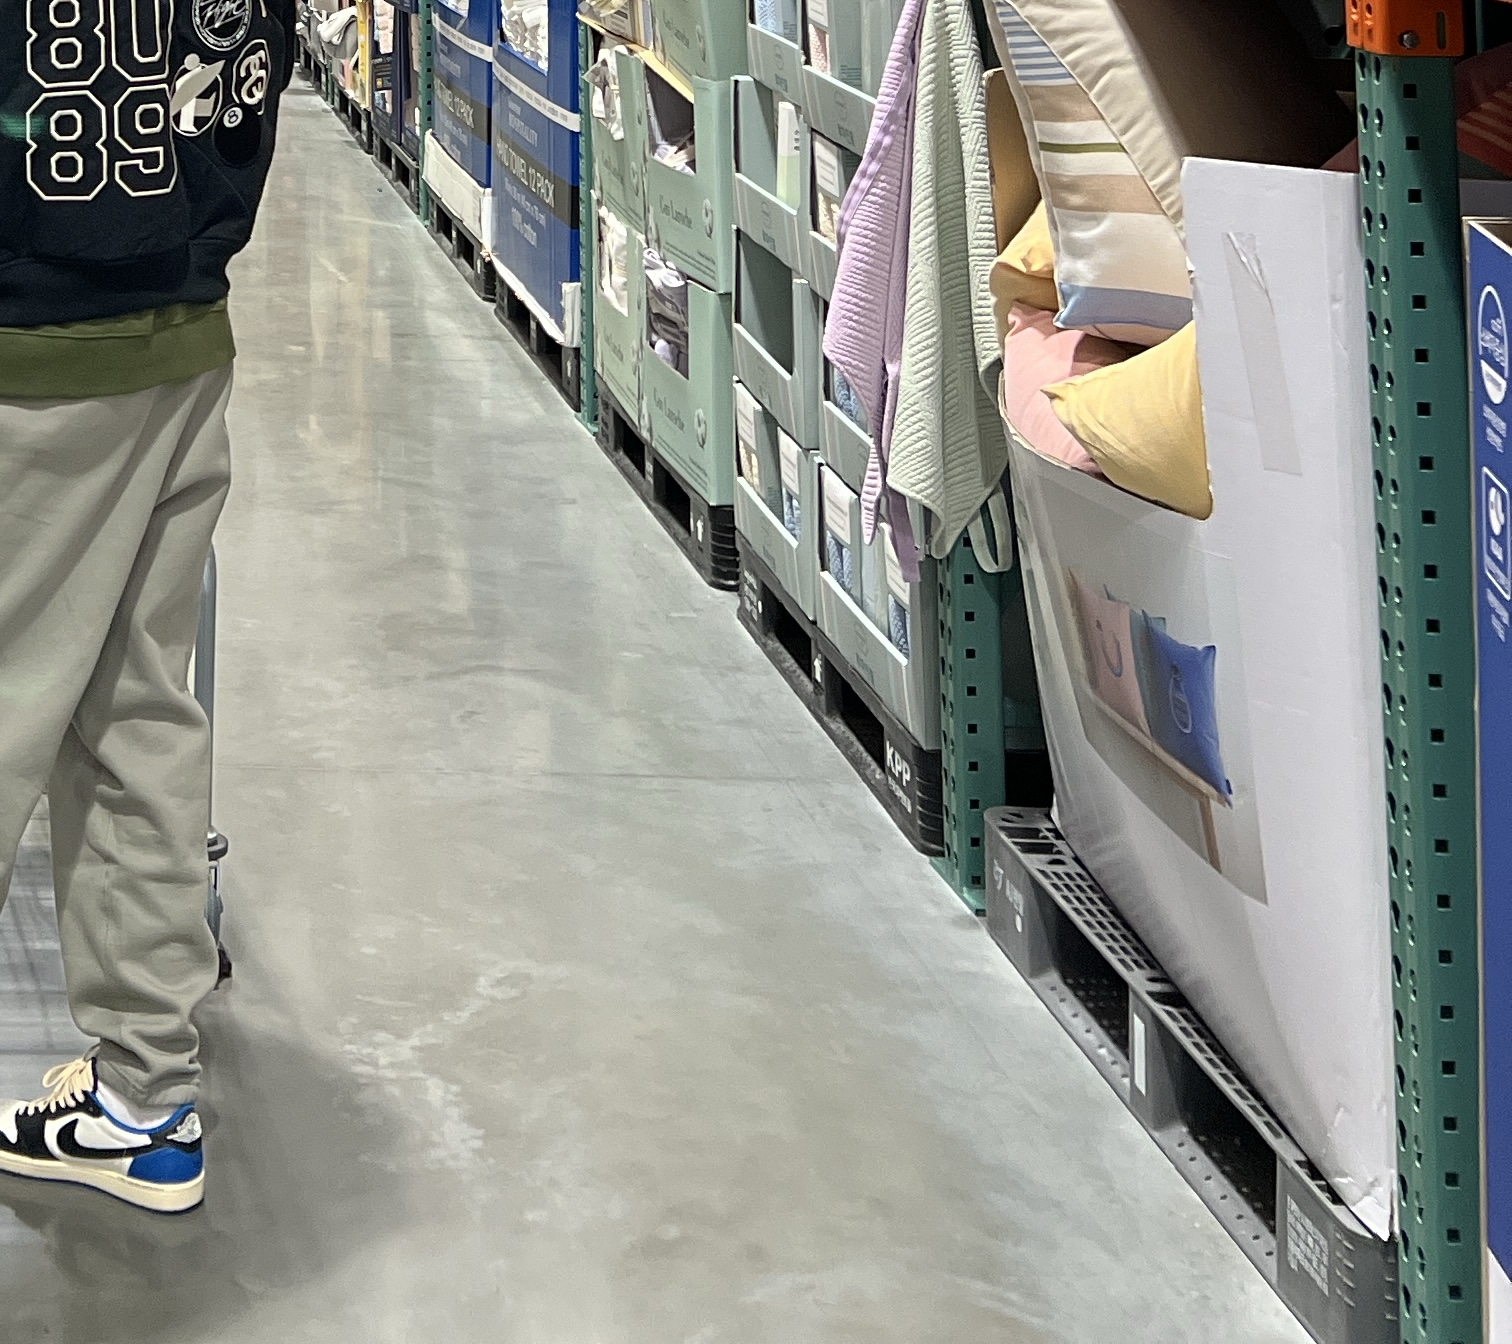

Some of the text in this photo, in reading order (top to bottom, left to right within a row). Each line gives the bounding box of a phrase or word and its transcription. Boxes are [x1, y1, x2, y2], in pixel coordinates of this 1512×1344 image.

[226, 108, 239, 125] 8
[26, 83, 178, 201] 89
[536, 170, 555, 209] PACK
[886, 741, 912, 786] KPP
